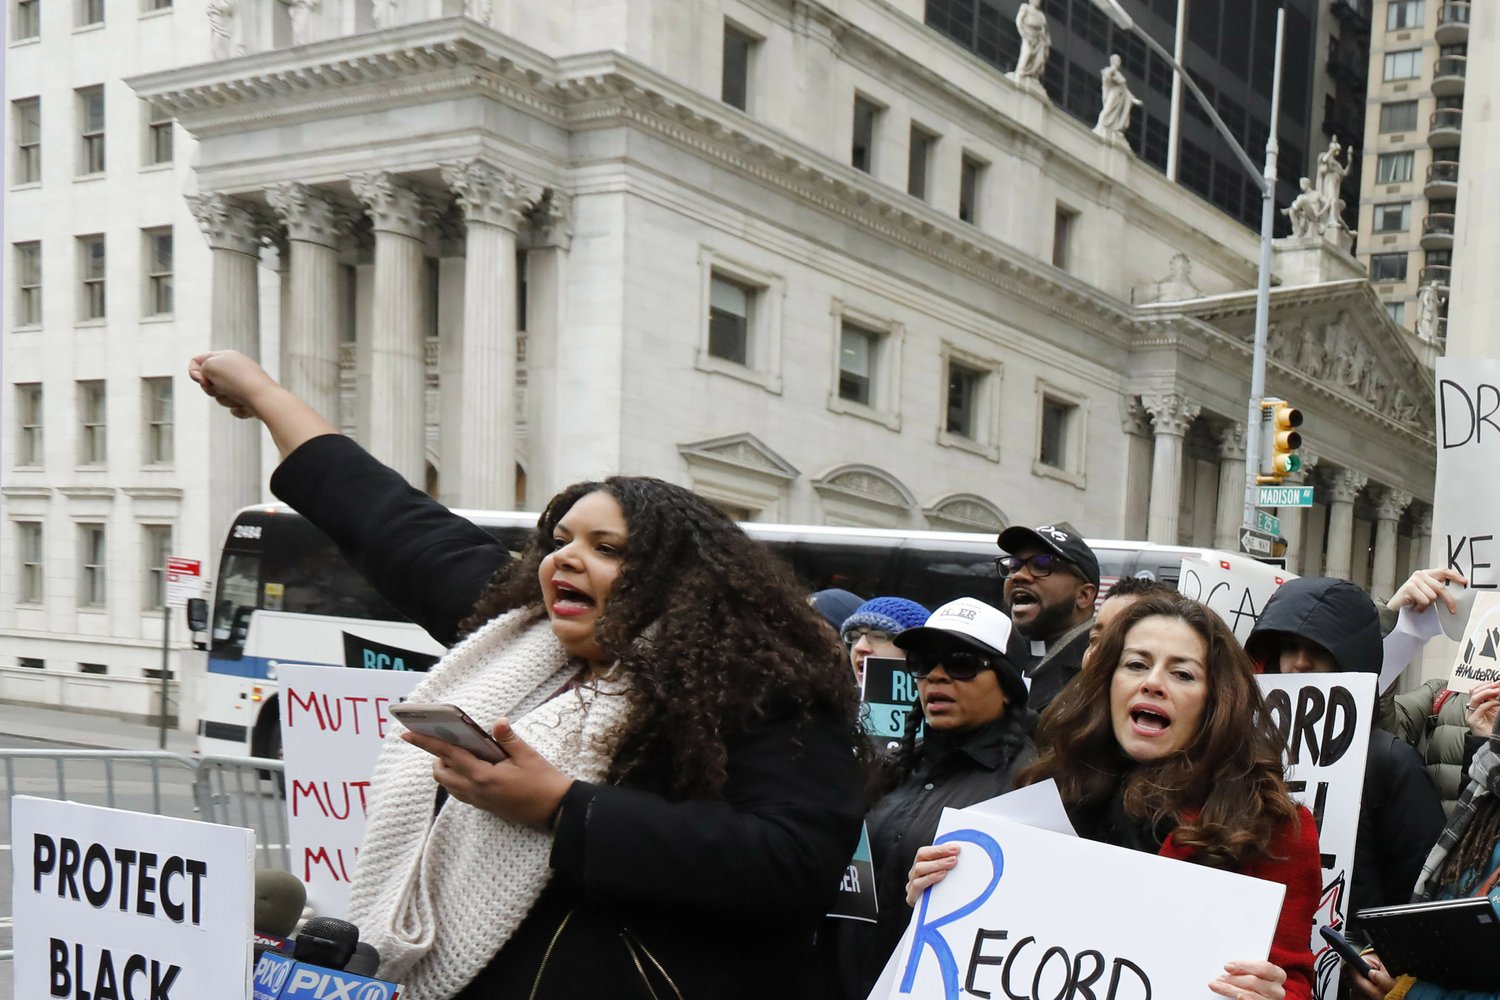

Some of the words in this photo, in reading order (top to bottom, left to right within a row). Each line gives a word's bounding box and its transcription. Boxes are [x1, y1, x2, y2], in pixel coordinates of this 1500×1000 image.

[1260, 489, 1300, 504] MADISON
[288, 688, 389, 739] MUTE
[33, 833, 207, 925] PROTECT
